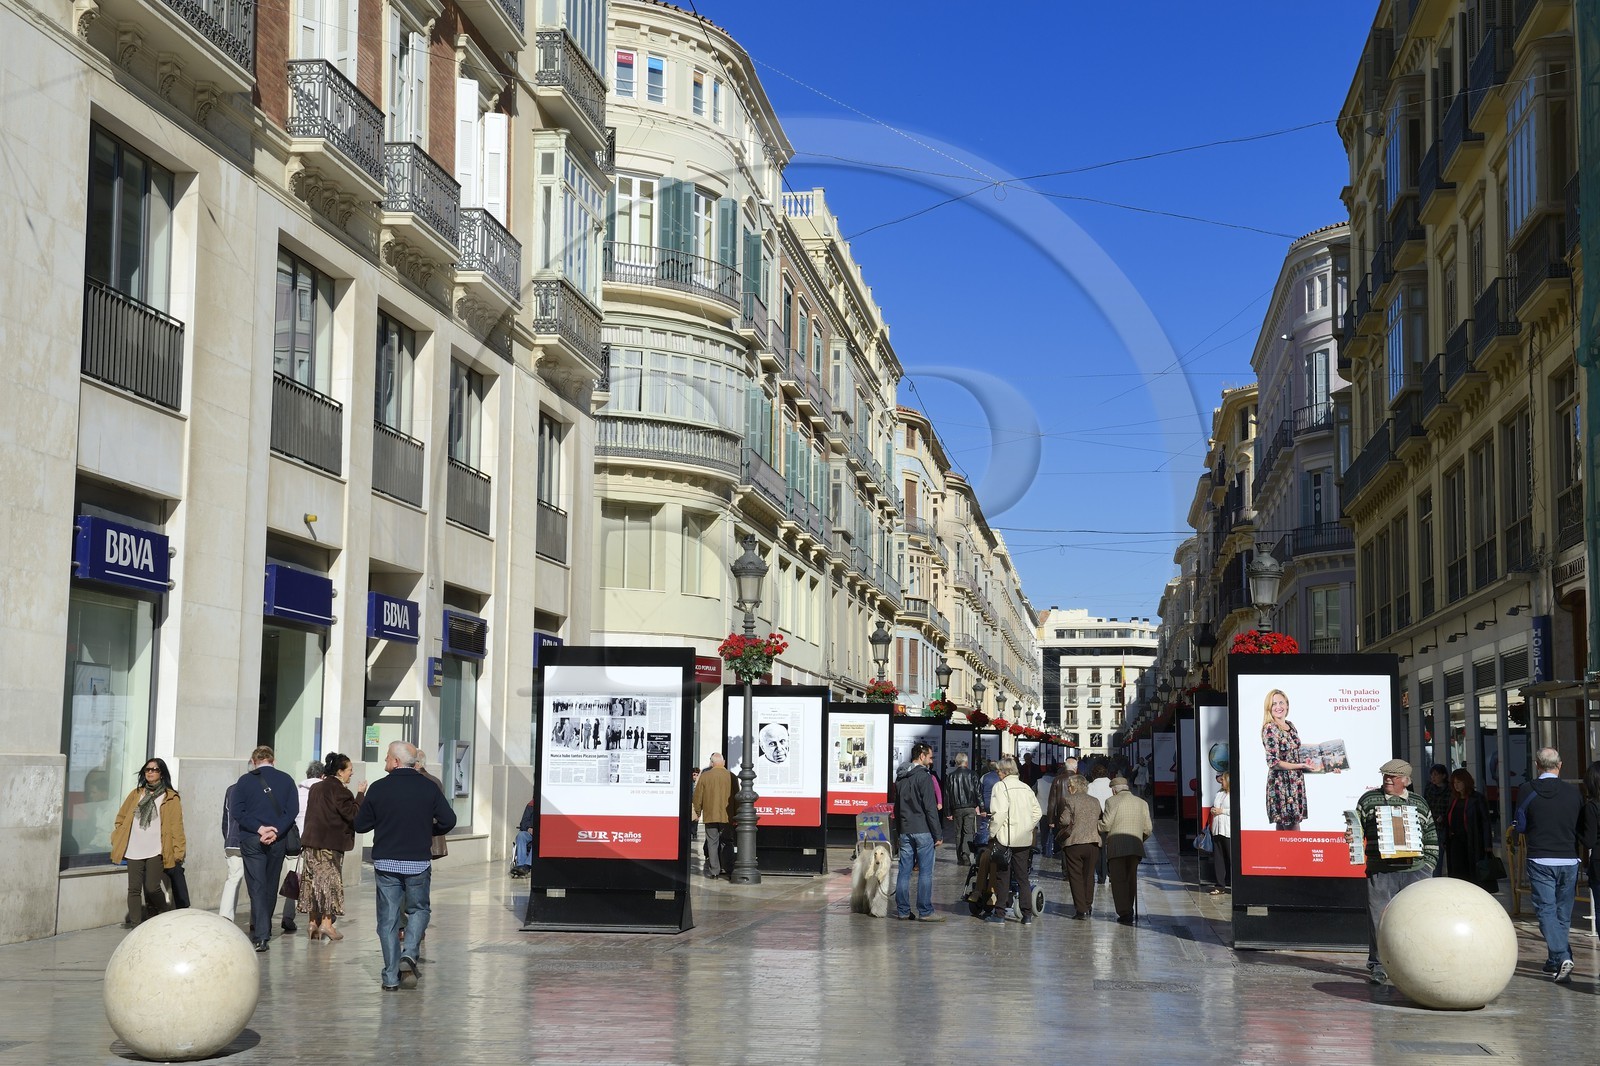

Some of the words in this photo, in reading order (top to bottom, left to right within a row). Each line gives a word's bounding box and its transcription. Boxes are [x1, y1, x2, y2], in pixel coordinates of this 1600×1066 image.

[105, 528, 154, 573] BBVA
[383, 600, 410, 630] BBVA
[1353, 688, 1380, 696] palacio
[774, 807, 784, 816] 75
[577, 830, 609, 839] SUR
[611, 831, 624, 842] 75
